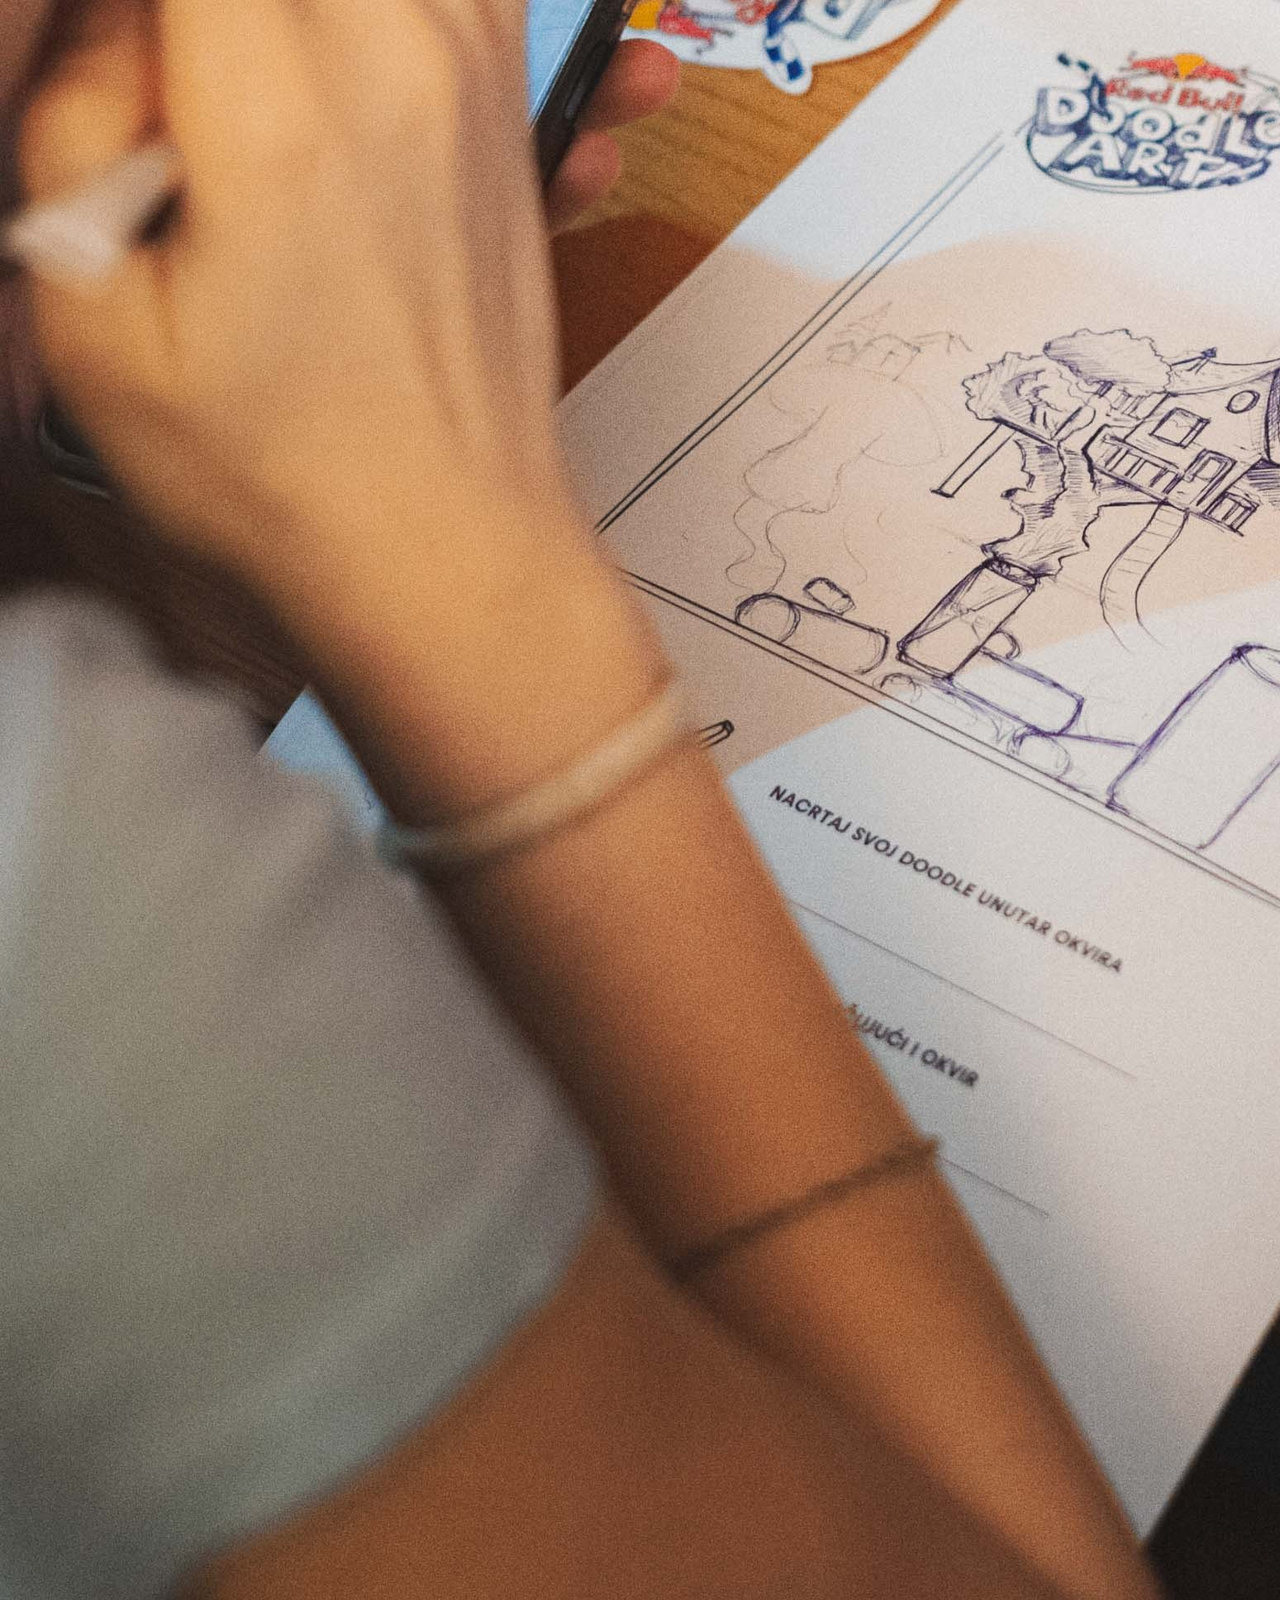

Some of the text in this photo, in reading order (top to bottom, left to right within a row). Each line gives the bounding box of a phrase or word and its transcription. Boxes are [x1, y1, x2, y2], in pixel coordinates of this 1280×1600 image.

[1105, 78, 1246, 113] Red Bull
[769, 784, 1124, 974] NACRTAJ SVOJ DOODLE UNUTAR OKVIRA
[909, 1041, 921, 1058] I
[921, 1048, 979, 1088] OKVIR
